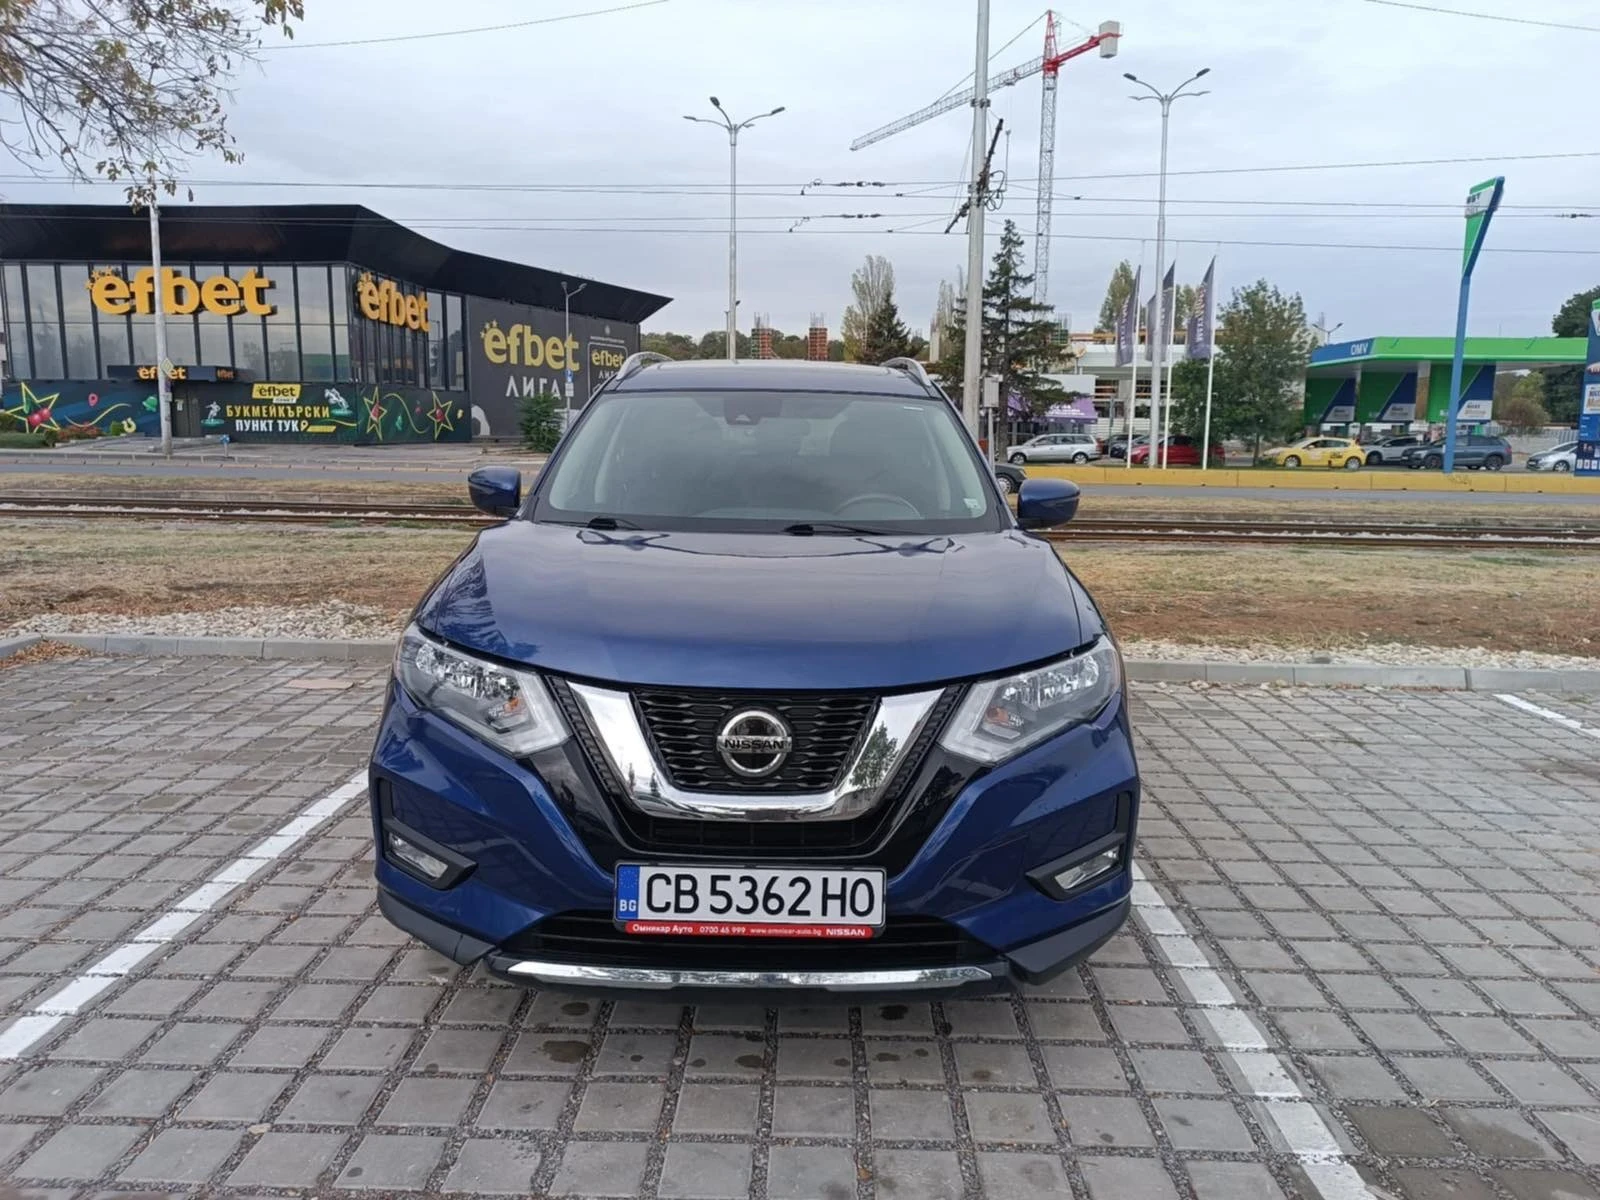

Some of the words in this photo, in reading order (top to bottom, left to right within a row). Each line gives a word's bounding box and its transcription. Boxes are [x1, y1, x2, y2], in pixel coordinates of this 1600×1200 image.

[91, 266, 272, 315] efbet
[358, 279, 430, 333] efbet
[483, 323, 580, 372] efbet
[1351, 342, 1369, 355] OMV
[591, 349, 624, 368] efbet
[139, 365, 187, 379] efet
[259, 386, 297, 397] efbet
[505, 375, 561, 400] ЛИГА
[226, 404, 330, 418] БУКМЕЙКЪРСКИ
[235, 420, 273, 432] ПУНКТ
[277, 420, 300, 432] ТУК
[724, 739, 784, 750] NISSAN
[619, 899, 637, 912] BG
[826, 928, 866, 937] NISSAN
